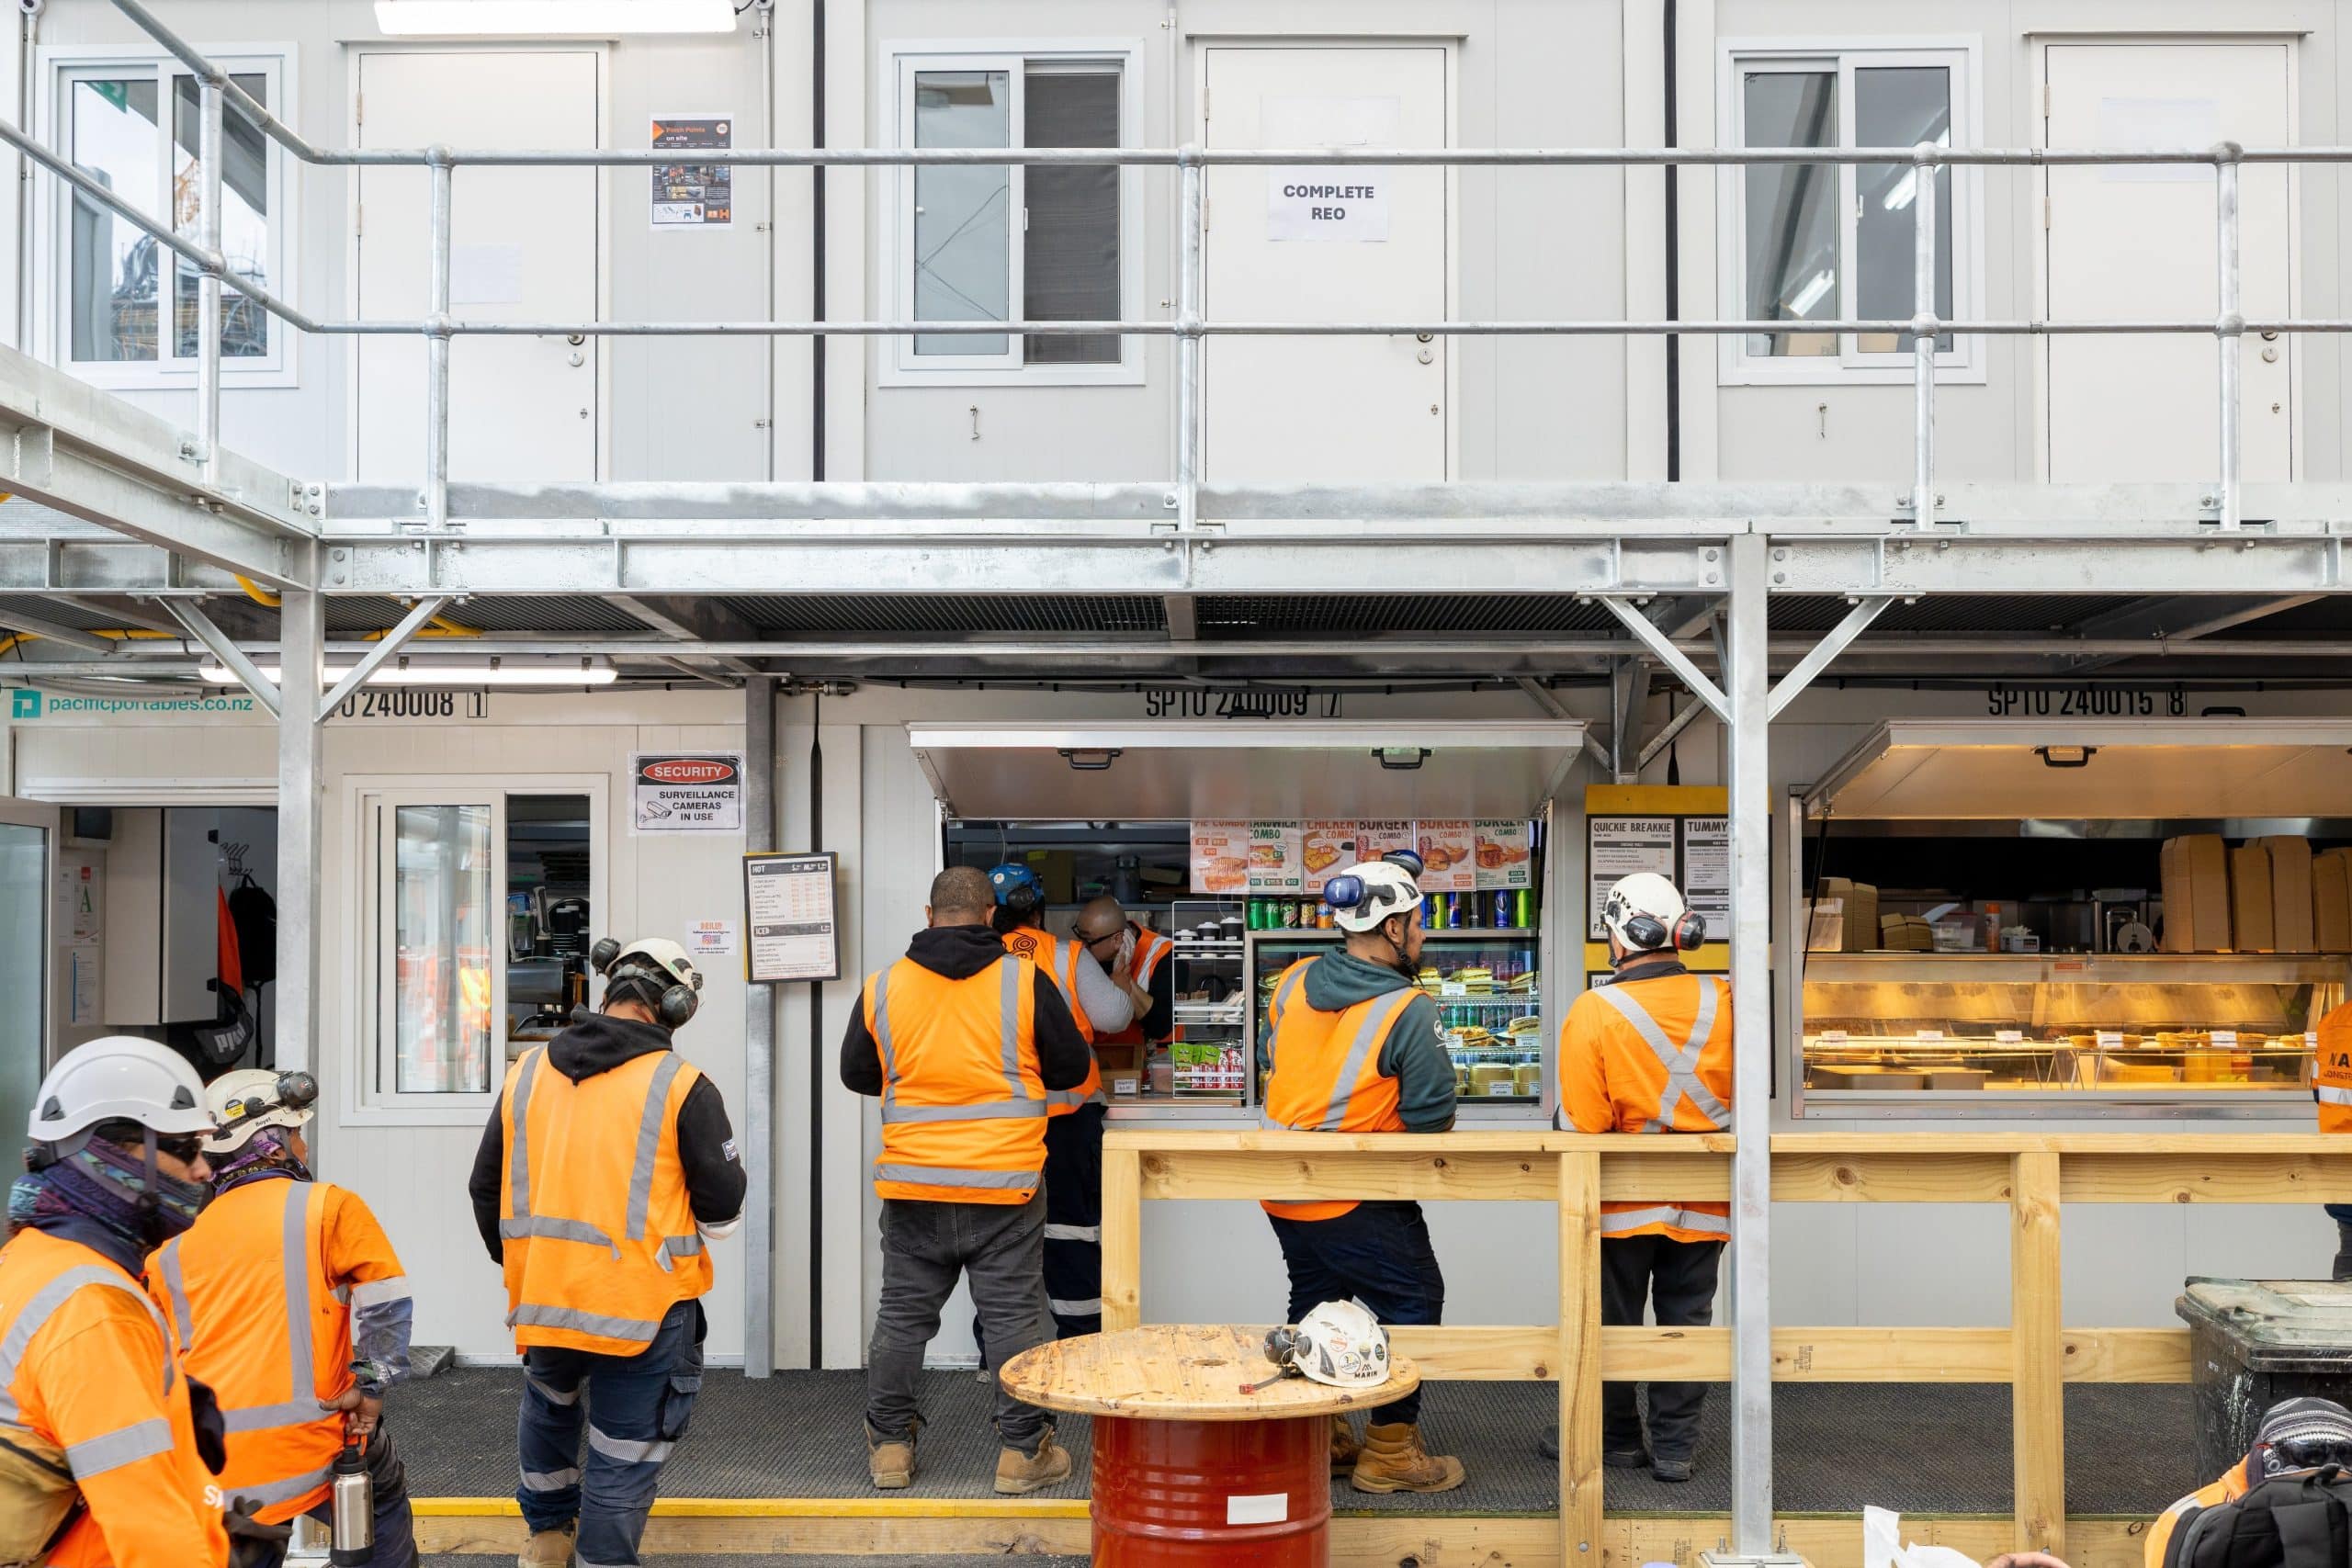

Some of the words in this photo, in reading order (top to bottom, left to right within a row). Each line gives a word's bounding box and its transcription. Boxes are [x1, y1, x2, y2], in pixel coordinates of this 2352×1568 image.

[1283, 185, 1374, 198] COMPLETE
[1311, 207, 1346, 220] REO
[361, 691, 454, 717] 240008
[2059, 690, 2154, 716] 240015
[654, 766, 722, 777] SECURITY
[659, 791, 735, 799] SURVEILLANCE
[673, 802, 721, 810] CAMERAS
[681, 813, 691, 821] IN
[695, 813, 714, 821] USE
[1306, 820, 1355, 830] CHICKEN
[1359, 820, 1409, 831] BURGER
[1419, 820, 1470, 830] BURGER
[1593, 822, 1627, 833] QUICKIE
[1630, 822, 1672, 832] BREAKKIE
[1687, 821, 1728, 832] TUMMY
[1326, 829, 1355, 840] COMBO
[1378, 831, 1402, 840] COMBO
[1439, 830, 1463, 839] COMBO
[752, 865, 766, 874] HOT
